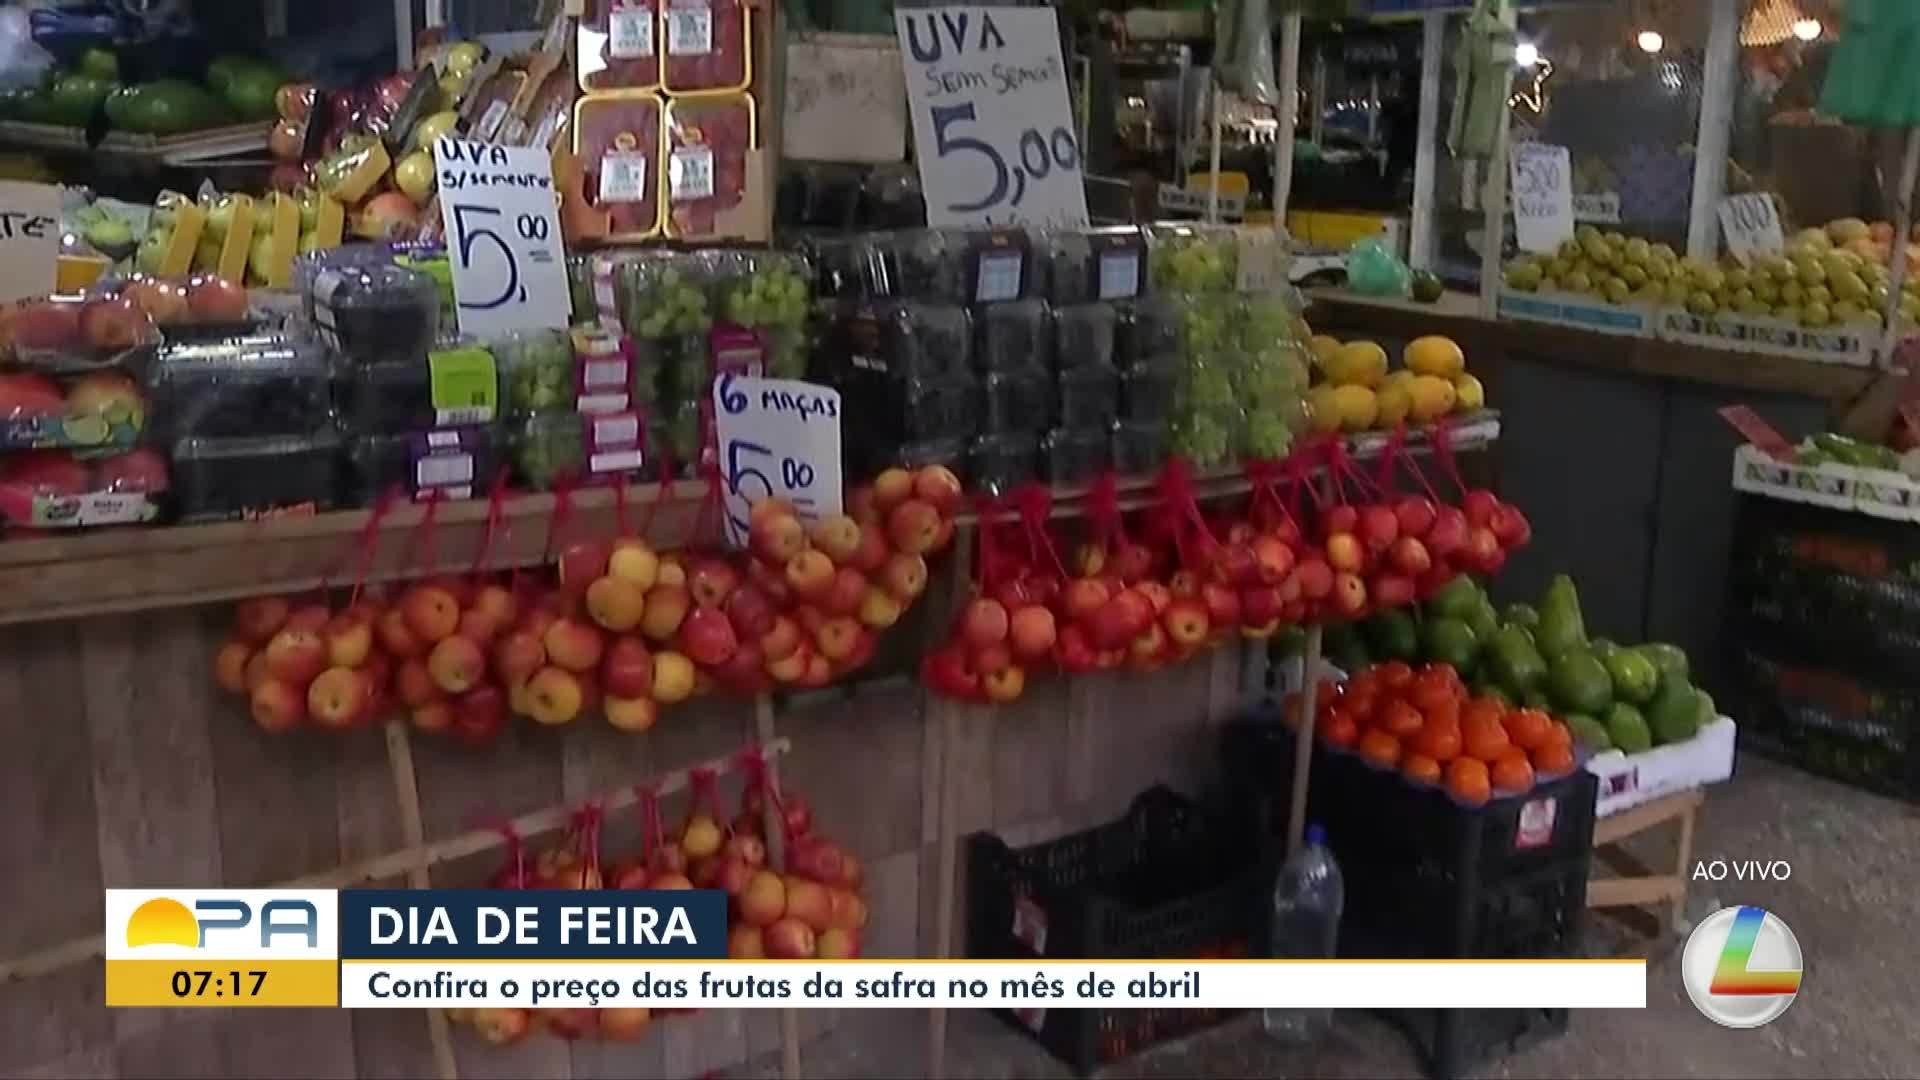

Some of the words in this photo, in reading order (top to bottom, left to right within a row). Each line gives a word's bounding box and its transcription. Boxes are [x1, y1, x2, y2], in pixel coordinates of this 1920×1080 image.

[906, 11, 1006, 63] UVA
[441, 139, 508, 166] UVA
[930, 101, 1077, 212] 5,00
[720, 375, 748, 414] 6
